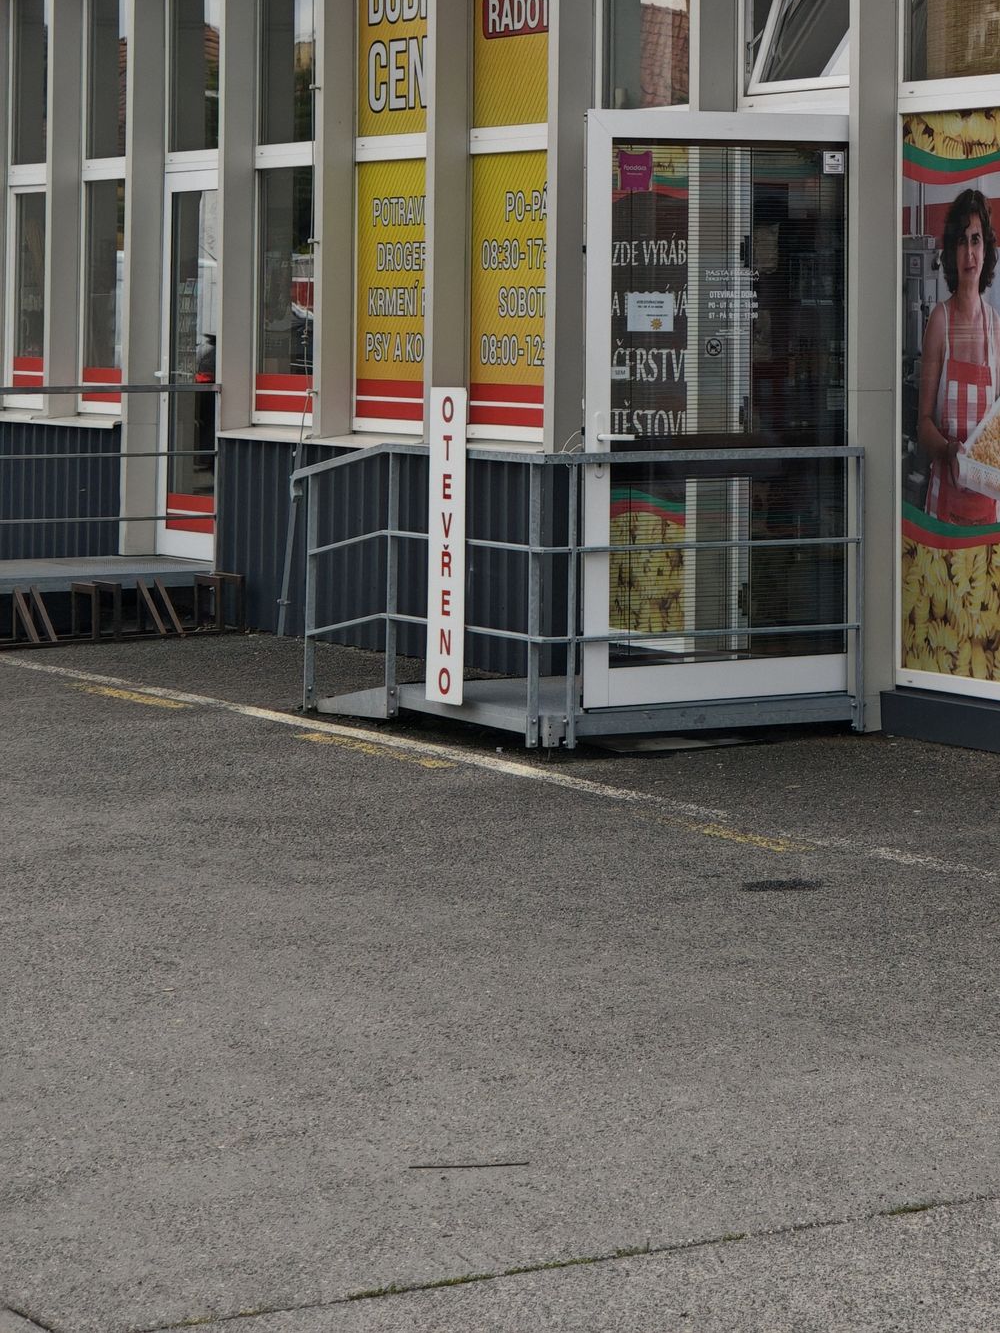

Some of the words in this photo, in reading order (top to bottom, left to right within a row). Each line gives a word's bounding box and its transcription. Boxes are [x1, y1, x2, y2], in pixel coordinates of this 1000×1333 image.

[611, 240, 639, 267] ZDE
[368, 279, 419, 317] KRMENÍ
[365, 332, 392, 363] PSY
[393, 332, 403, 363] A
[438, 396, 454, 696] OTEVŘENO
